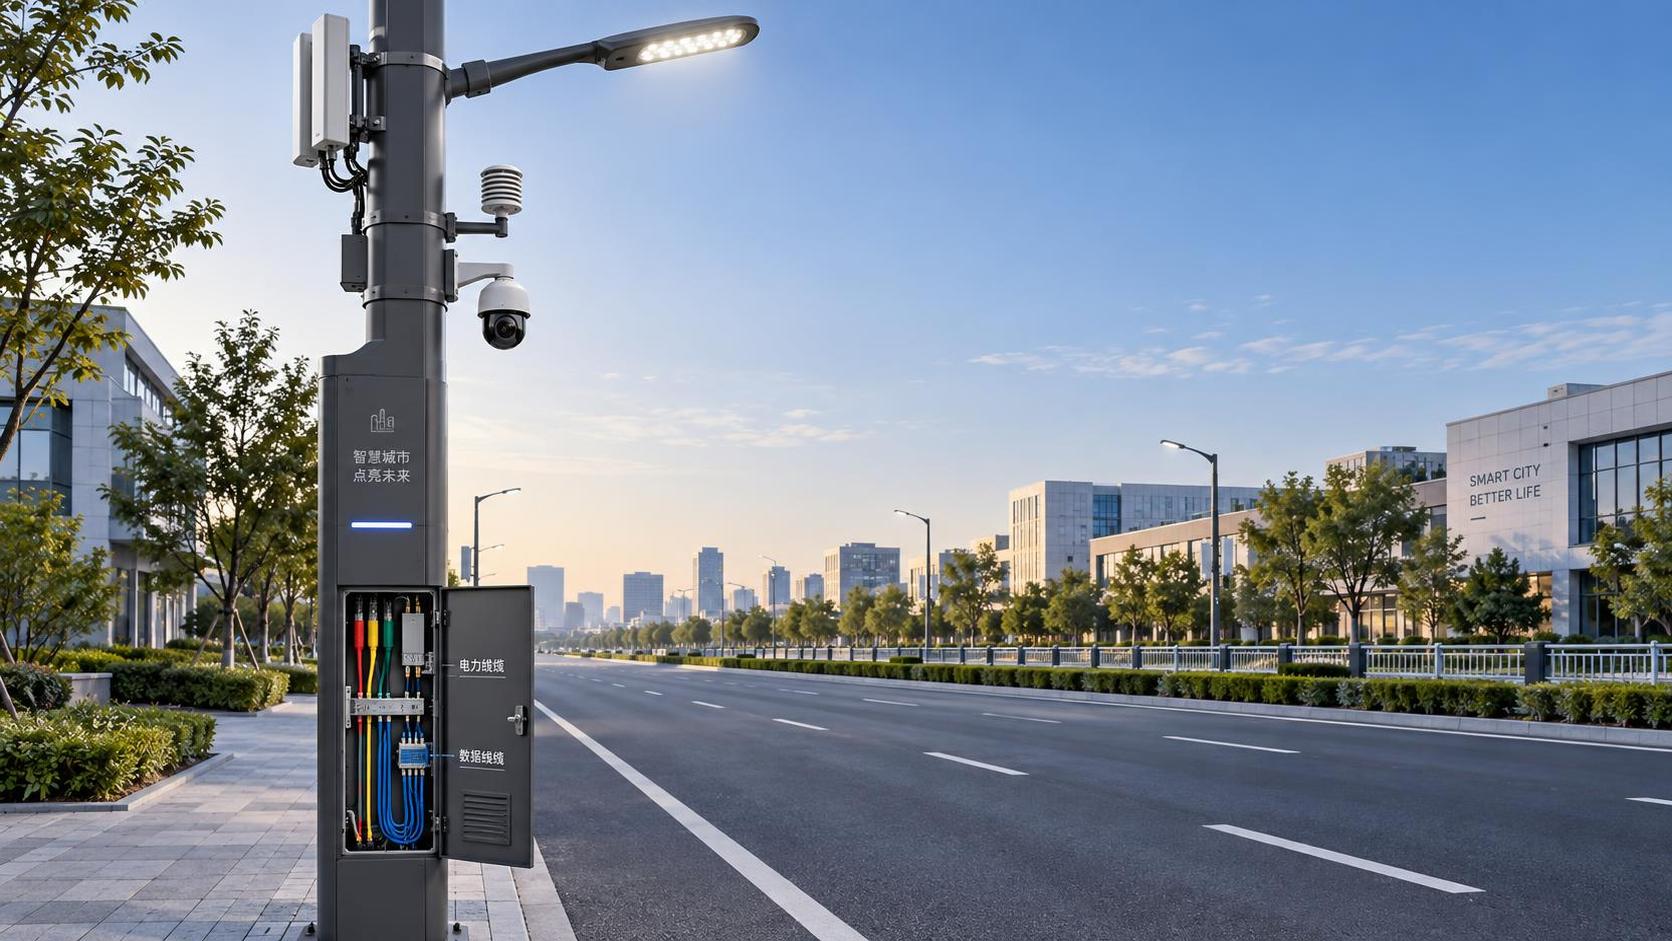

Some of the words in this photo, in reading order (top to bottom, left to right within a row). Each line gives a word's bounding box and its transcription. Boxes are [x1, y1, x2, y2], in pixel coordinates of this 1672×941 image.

[353, 449, 411, 464] 智慧城市
[353, 468, 411, 483] 点亮未来
[1470, 469, 1510, 487] SMART
[1513, 464, 1541, 480] CITY
[1470, 489, 1512, 506] BETTER
[1516, 484, 1541, 500] LIFE
